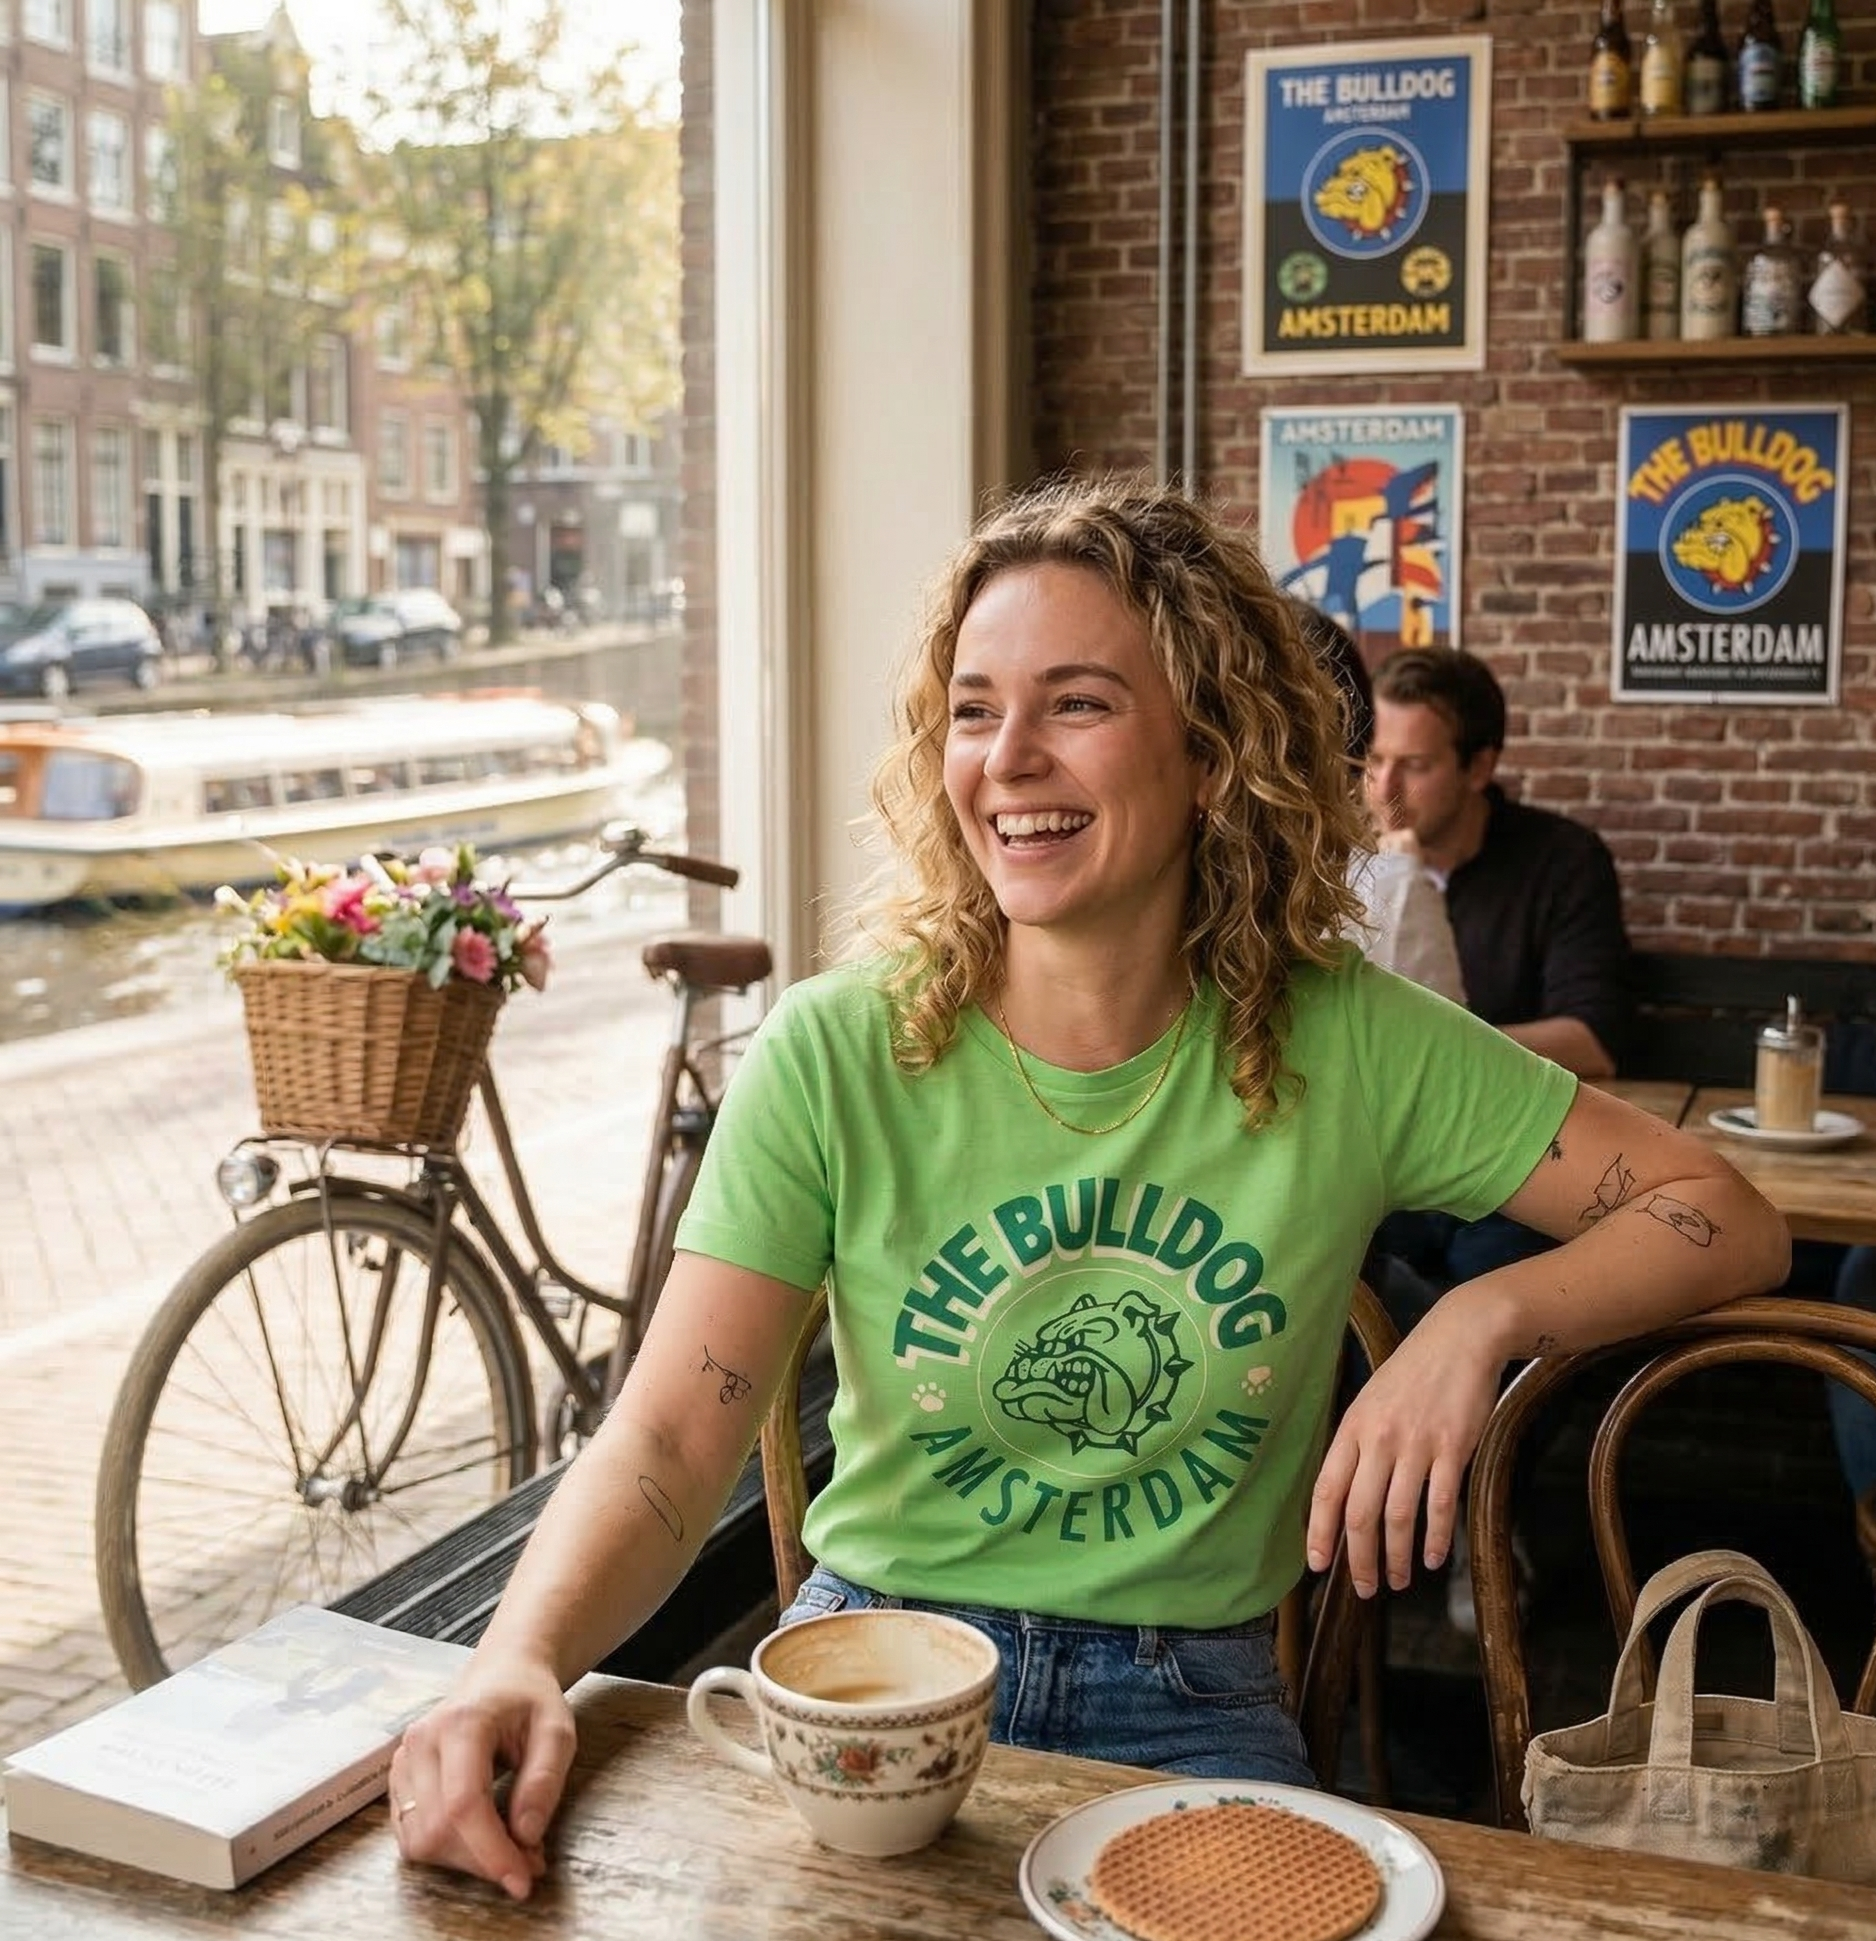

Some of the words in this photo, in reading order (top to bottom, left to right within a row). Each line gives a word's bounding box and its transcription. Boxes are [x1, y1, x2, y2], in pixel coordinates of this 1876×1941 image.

[1280, 75, 1331, 107] THE
[1336, 69, 1455, 105] BULLDOG
[1278, 303, 1451, 338] AMSTERDAM
[1280, 418, 1445, 443] AMSTERDAM
[1628, 437, 1691, 504] THE
[1687, 421, 1835, 504] BULLDOG
[1627, 622, 1825, 663] AMSTERDAM
[893, 1222, 1011, 1369] THE
[989, 1177, 1287, 1350] BULLDOG
[909, 1408, 1271, 1543] AMSTERDAM
